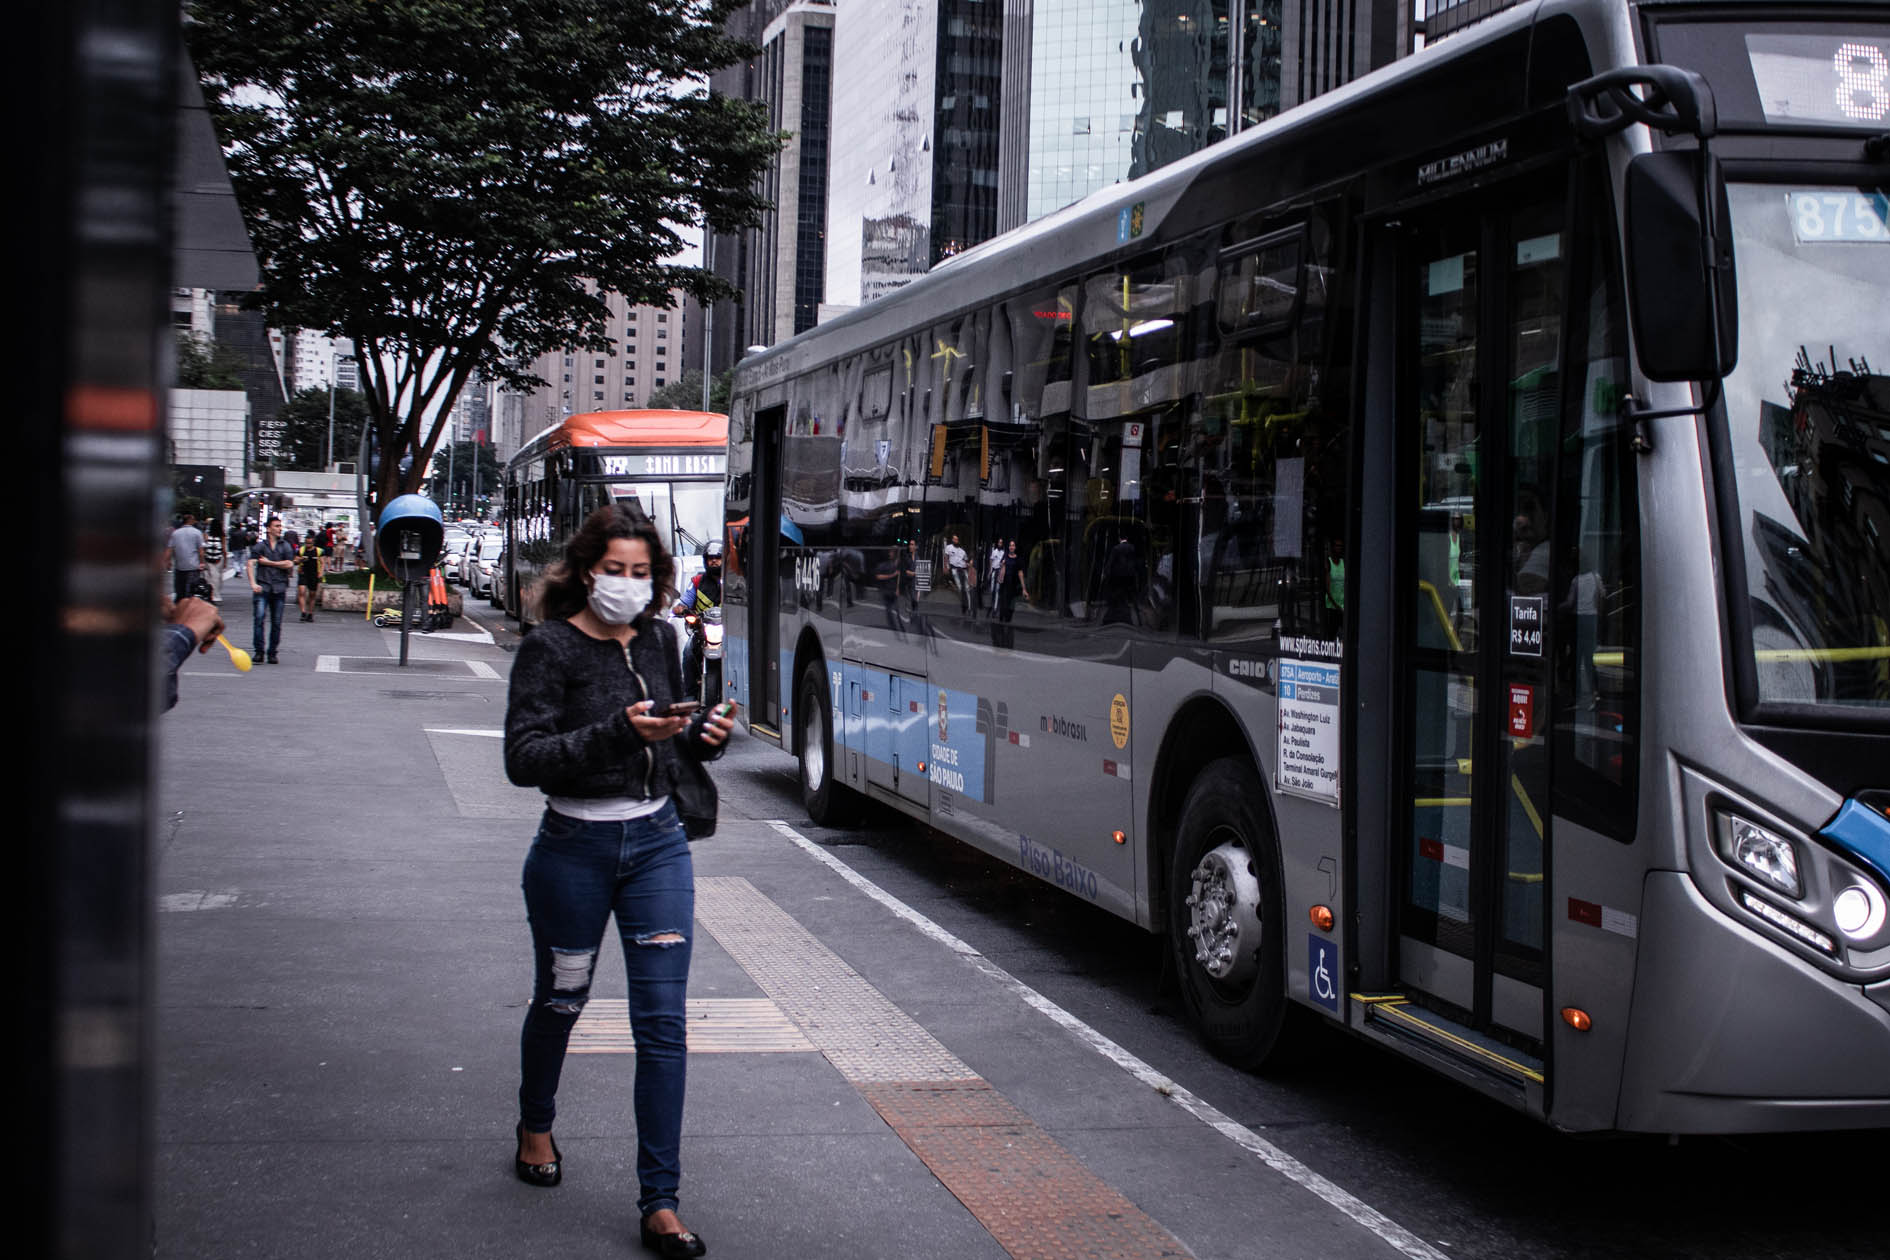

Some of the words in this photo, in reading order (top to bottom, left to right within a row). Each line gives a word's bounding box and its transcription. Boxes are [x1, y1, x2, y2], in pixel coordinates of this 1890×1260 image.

[1834, 43, 1889, 120] 8
[1418, 139, 1507, 185] MILLENNIUM
[1797, 195, 1890, 238] 875
[1514, 606, 1537, 620] Tarifa
[1512, 629, 1522, 644] R$
[1524, 630, 1540, 646] 4,40
[1297, 667, 1322, 682] Aeroporto
[1284, 685, 1291, 697] 10
[1297, 687, 1321, 701] Perdizes
[1291, 709, 1319, 723] Washington
[1040, 713, 1088, 742] mobibrasil
[1291, 723, 1316, 736] Jabaquara
[1291, 736, 1310, 748] Paulista
[932, 743, 951, 763] CIDADE
[951, 748, 958, 766] DE
[1289, 750, 1295, 760] da
[1296, 750, 1325, 765] Consolação
[930, 760, 942, 785] SÃO
[942, 767, 964, 793] PAULO
[1283, 761, 1302, 774] Terminal
[1303, 765, 1320, 777] Amaral
[1291, 776, 1301, 787] São
[1302, 779, 1314, 789] João
[1020, 834, 1050, 877] Piso
[1053, 847, 1097, 900] Baixo
